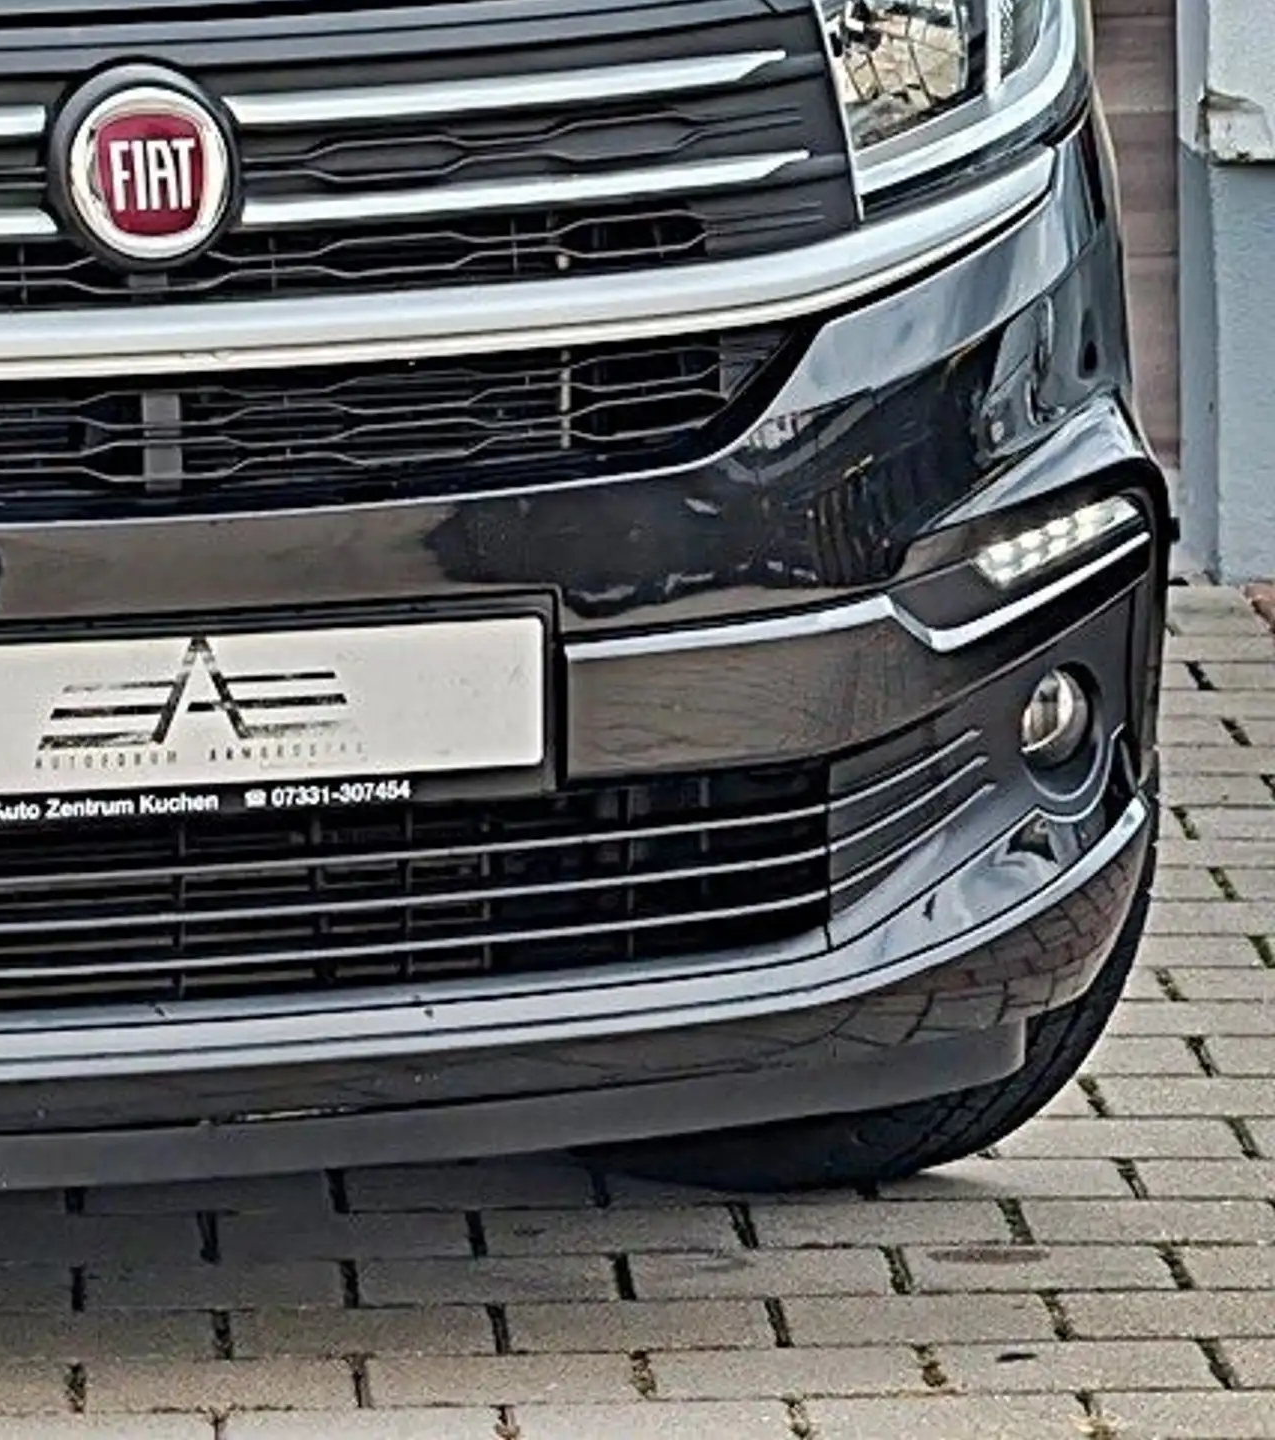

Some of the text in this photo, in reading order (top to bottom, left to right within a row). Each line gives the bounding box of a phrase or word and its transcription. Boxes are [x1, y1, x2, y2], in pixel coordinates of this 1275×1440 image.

[109, 138, 196, 212] FIAT
[45, 797, 135, 819] Zentrum
[139, 791, 220, 814] Kuchen
[271, 779, 411, 808] 07331-307454
